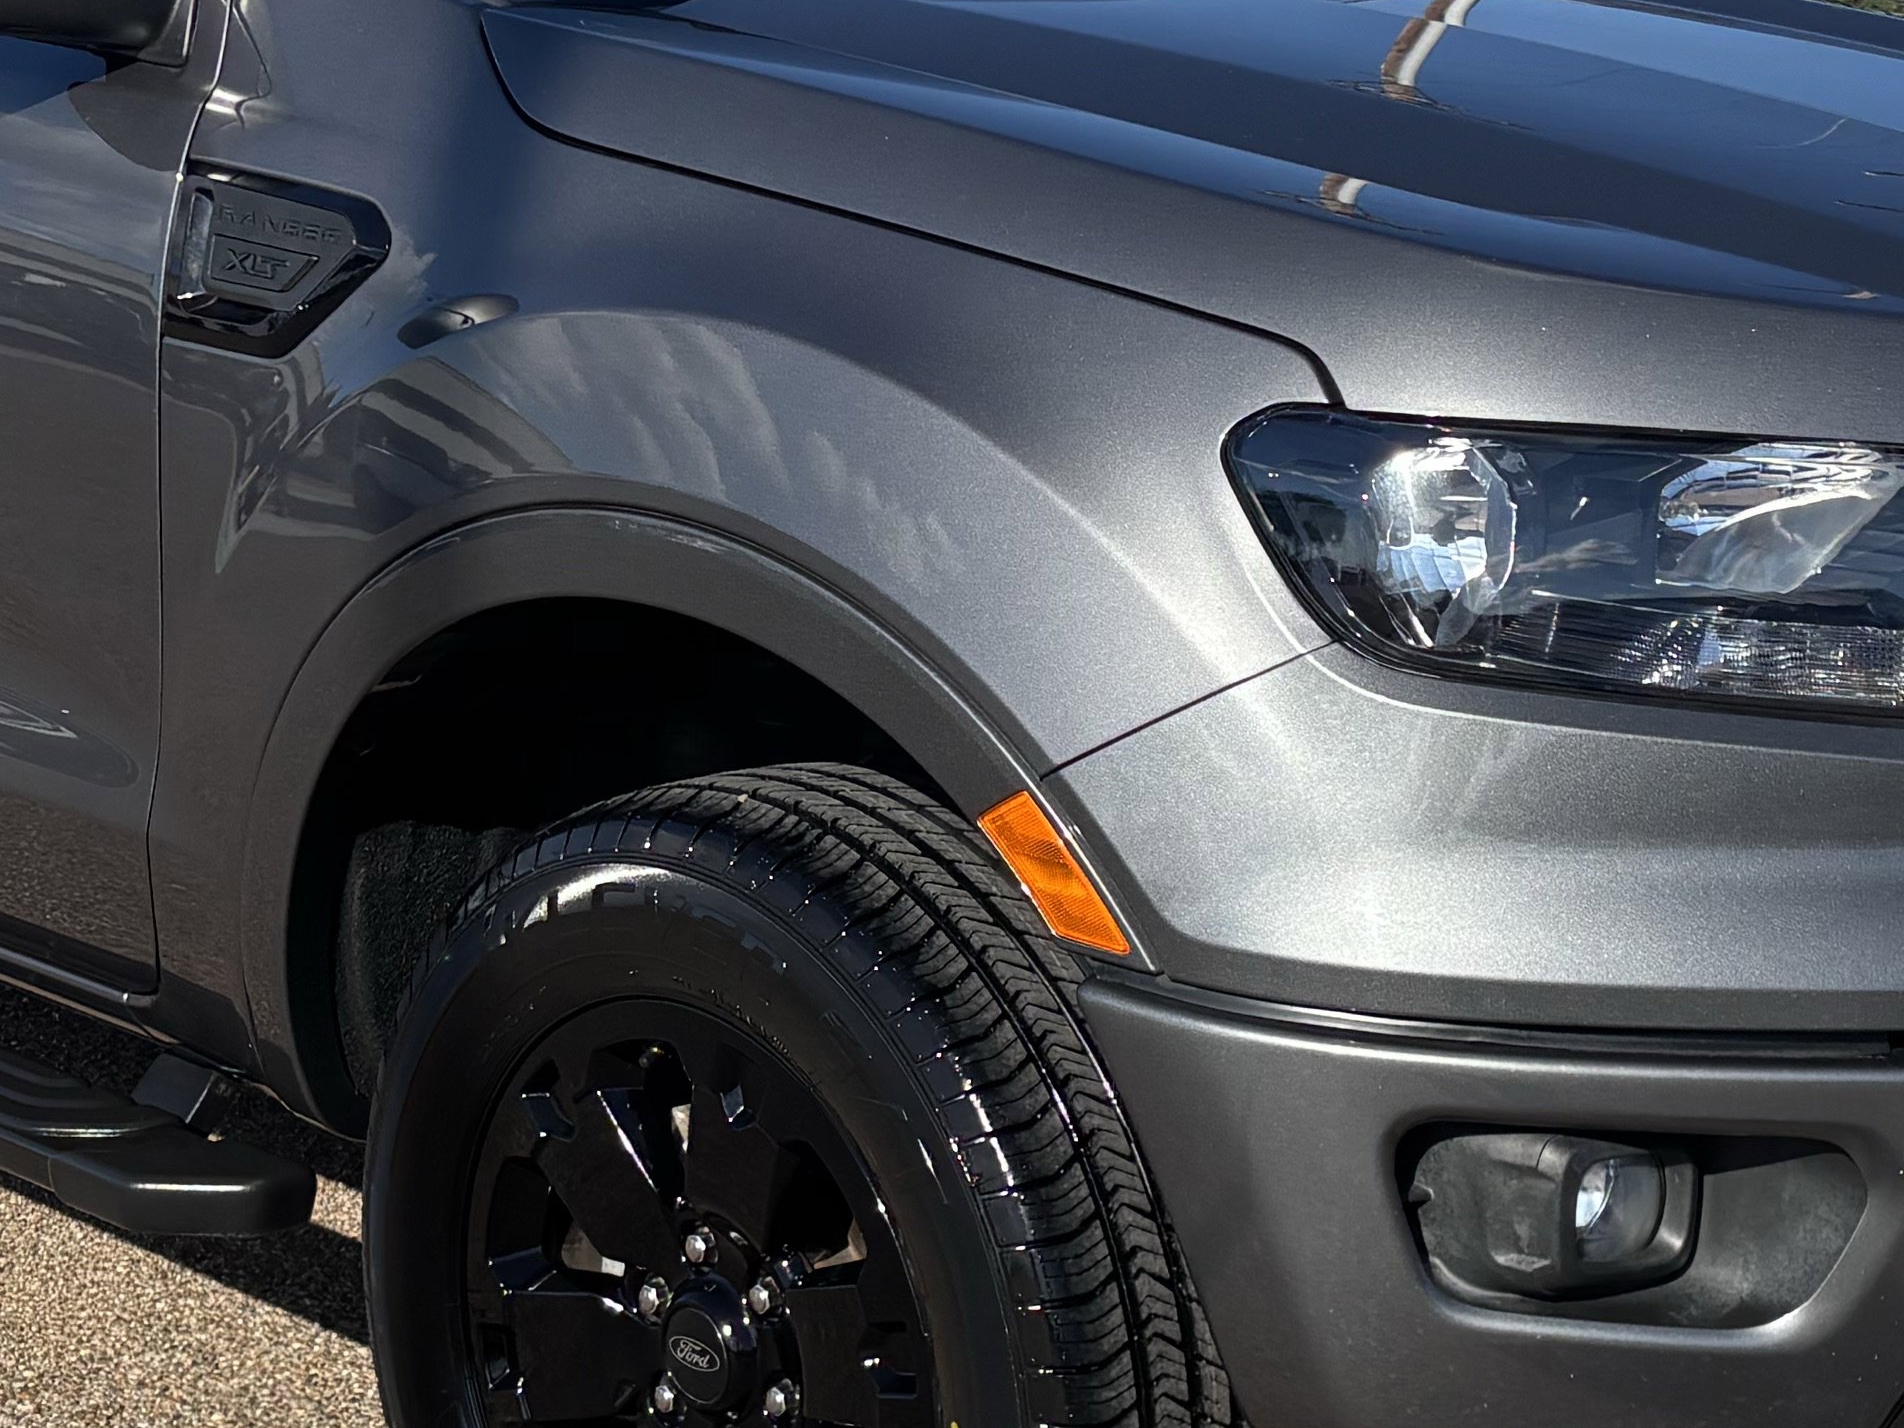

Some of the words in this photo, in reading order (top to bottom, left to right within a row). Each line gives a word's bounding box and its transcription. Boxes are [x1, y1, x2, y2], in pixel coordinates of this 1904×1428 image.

[218, 202, 344, 246] RANGER
[224, 247, 291, 279] XLT
[677, 1339, 710, 1368] Ford
